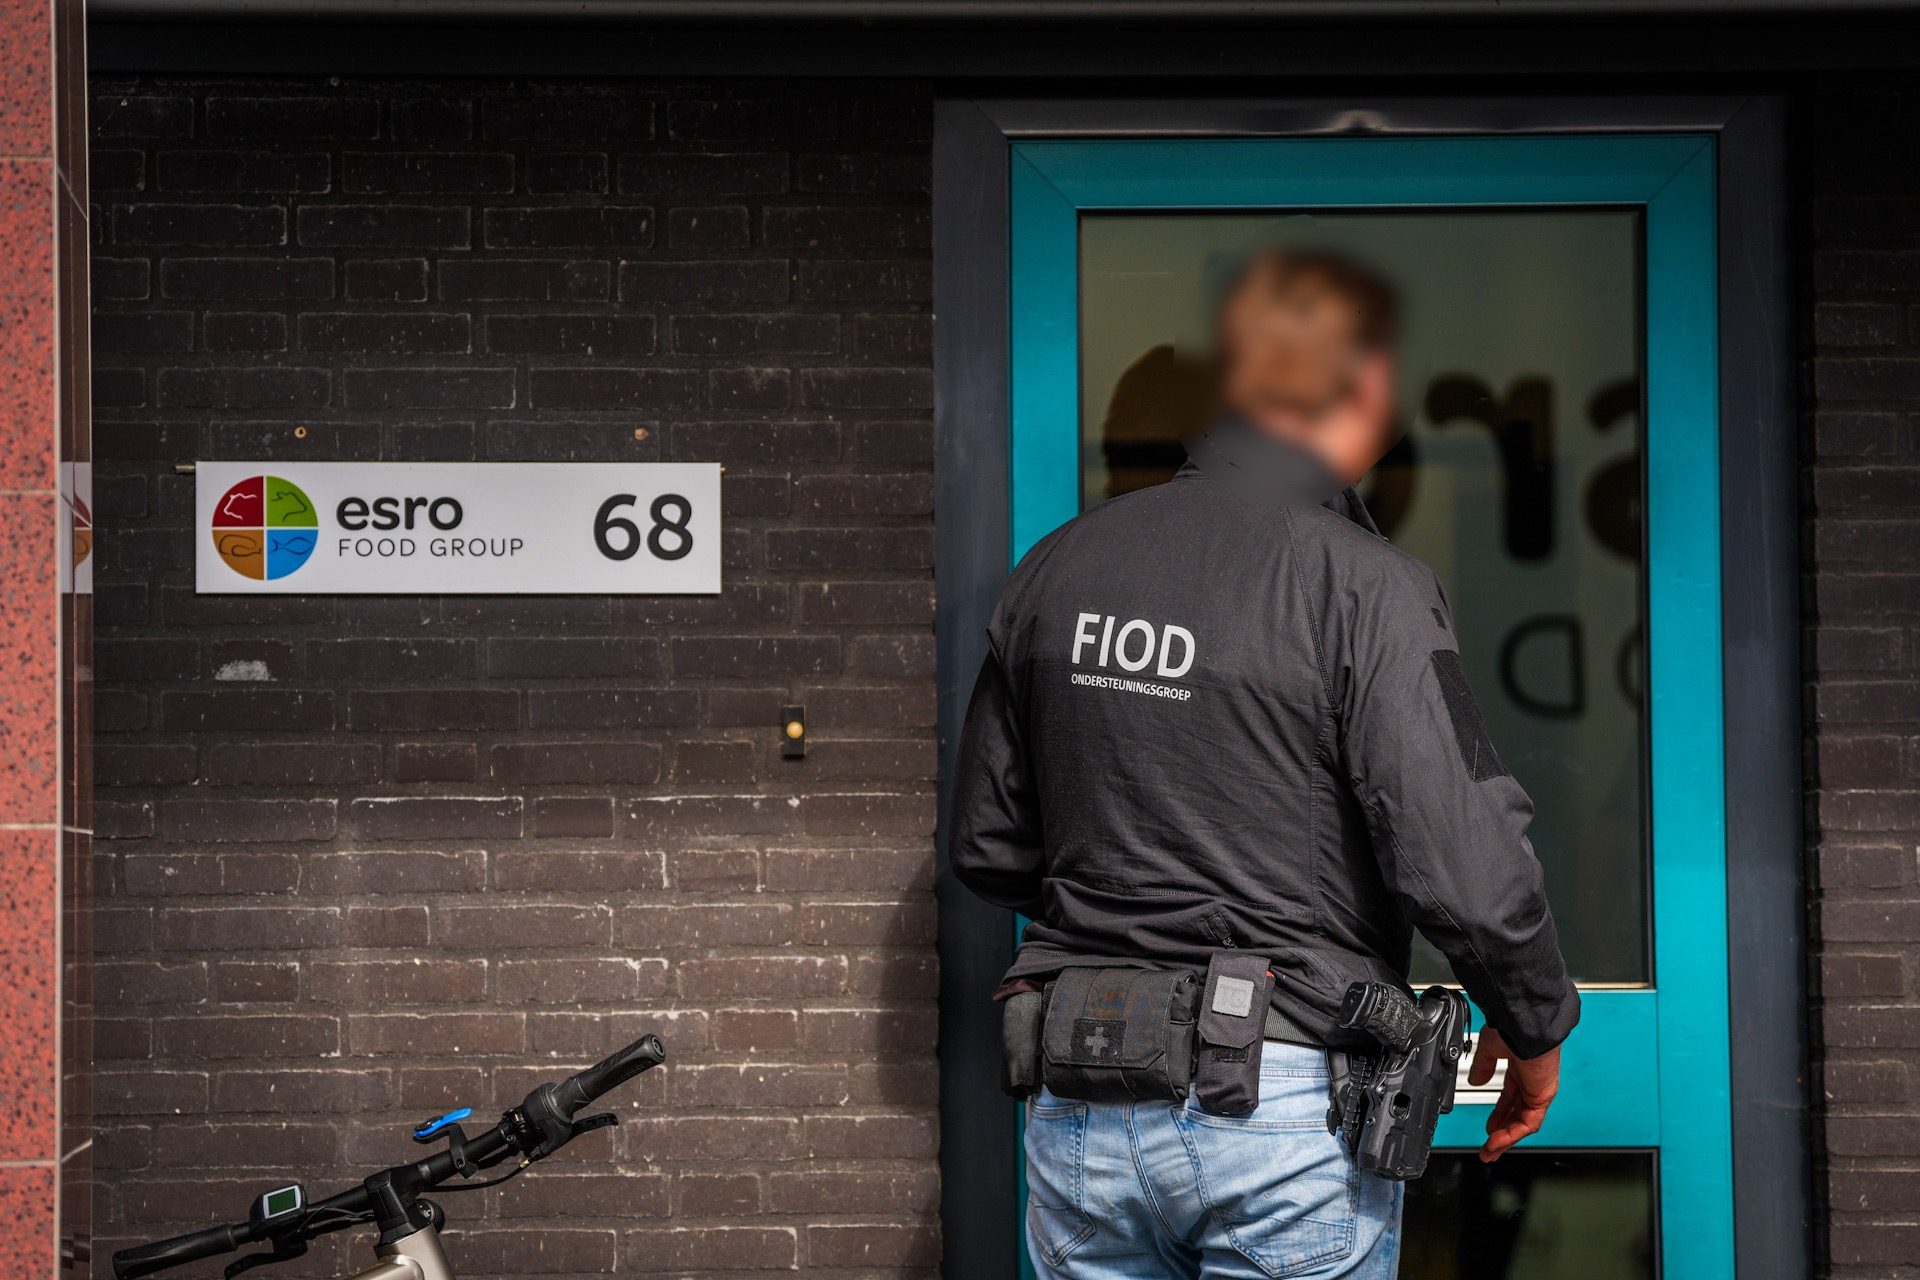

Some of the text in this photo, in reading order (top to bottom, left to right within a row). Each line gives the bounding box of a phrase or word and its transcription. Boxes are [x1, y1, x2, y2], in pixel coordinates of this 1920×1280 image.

[336, 496, 463, 531] esro
[593, 493, 693, 561] 68
[338, 538, 524, 557] FOOD GROUP
[1071, 612, 1196, 678] FIOD
[1071, 673, 1191, 701] ONDERSTEUNINGSGROEP
